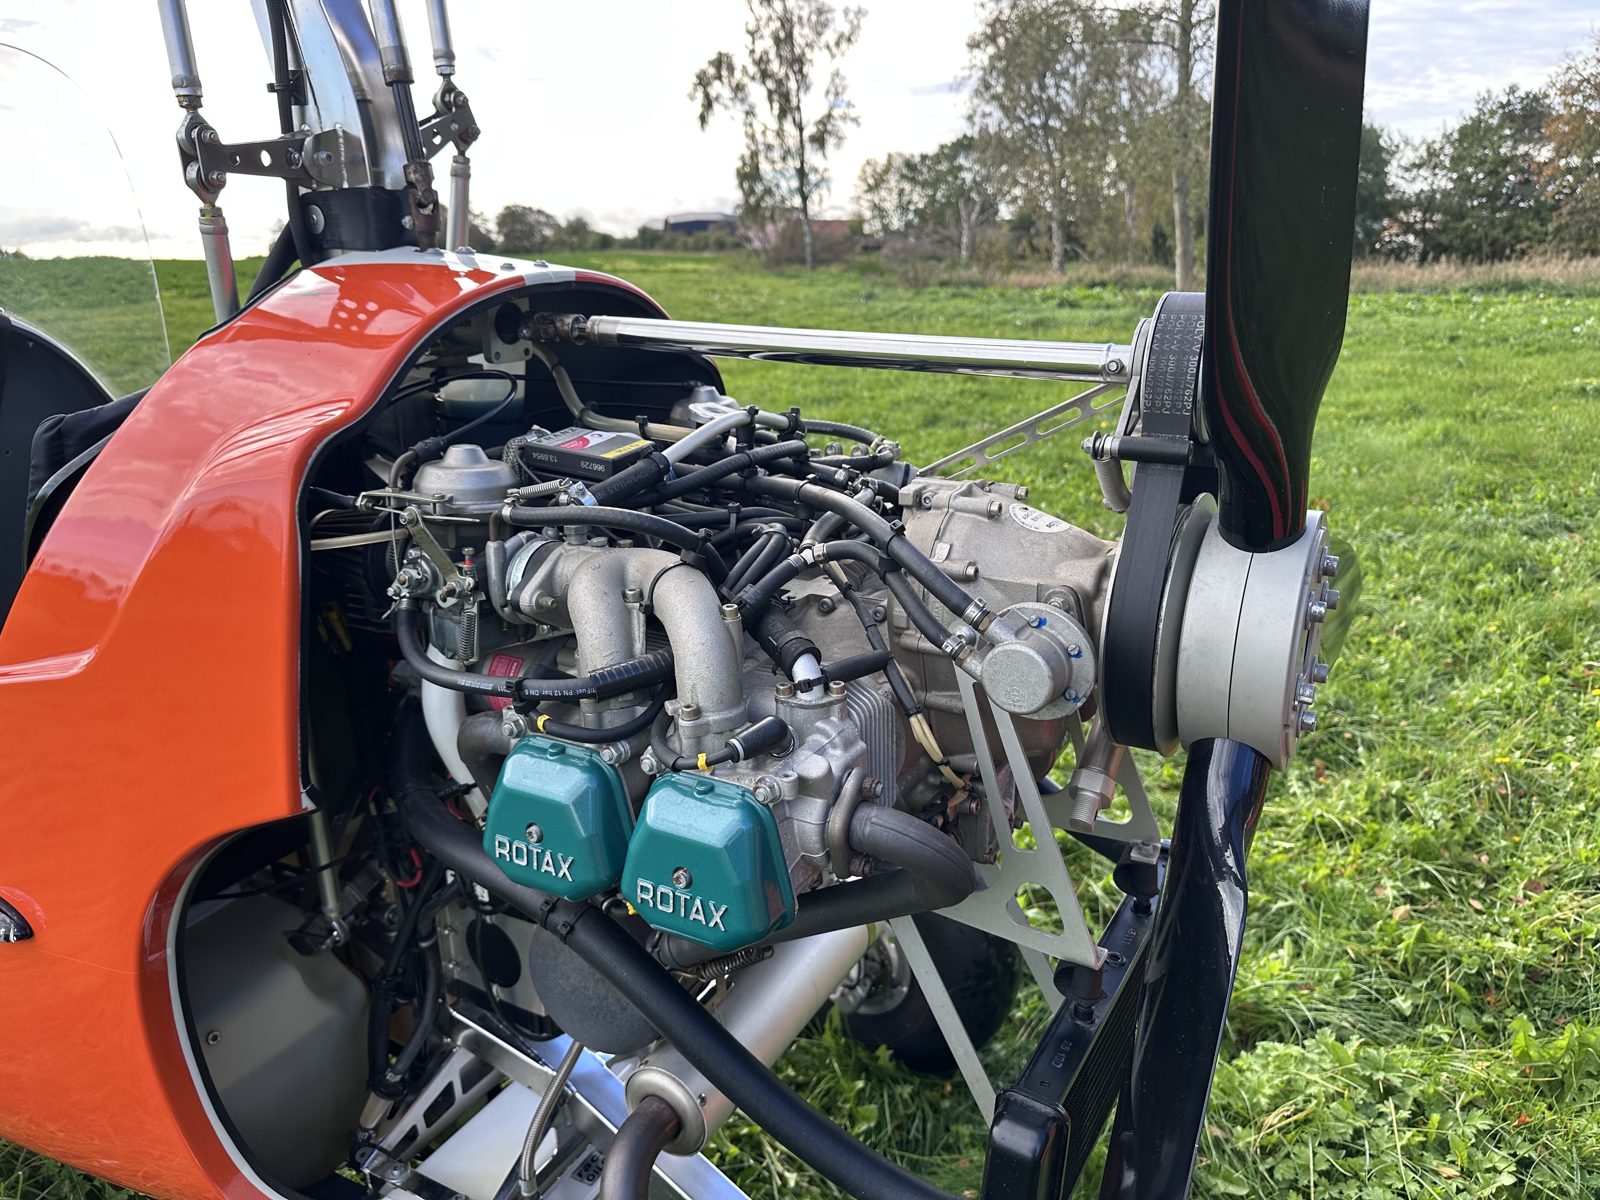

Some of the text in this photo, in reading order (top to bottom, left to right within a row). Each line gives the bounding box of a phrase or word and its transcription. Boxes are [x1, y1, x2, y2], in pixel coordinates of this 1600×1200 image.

[1170, 314, 1187, 351] POLY-V
[1191, 314, 1205, 352] POLY-V
[580, 461, 606, 472] 966729
[554, 689, 562, 697] 12
[495, 834, 574, 882] ROTAX
[637, 877, 728, 932] ROTAX
